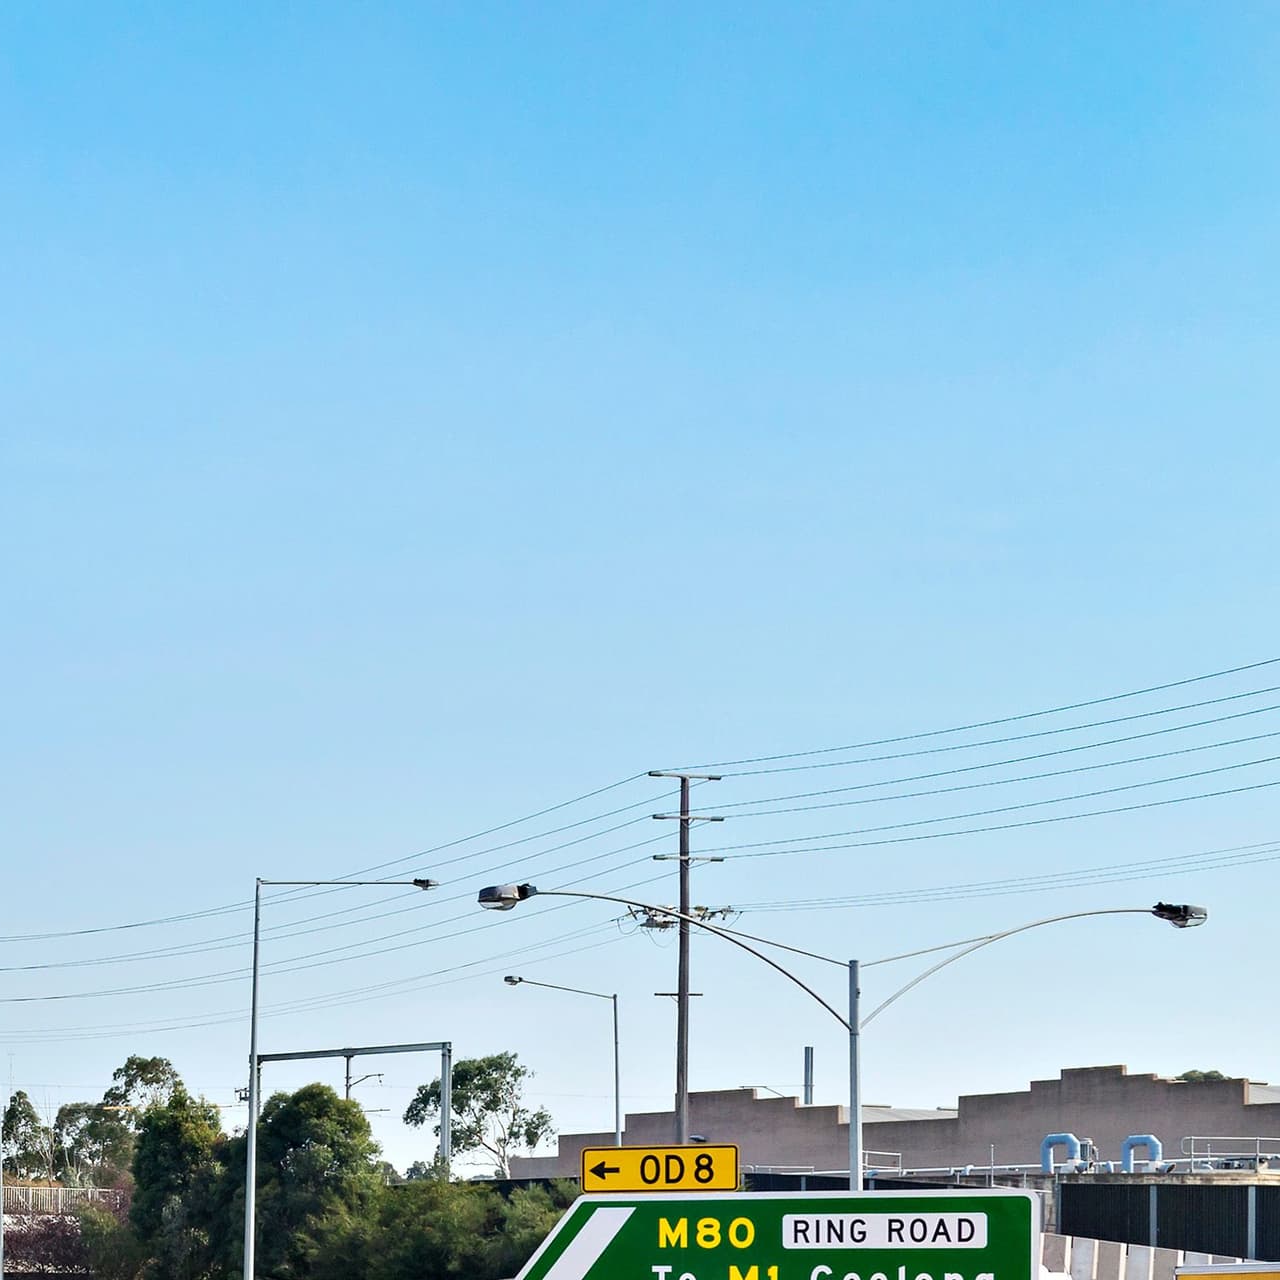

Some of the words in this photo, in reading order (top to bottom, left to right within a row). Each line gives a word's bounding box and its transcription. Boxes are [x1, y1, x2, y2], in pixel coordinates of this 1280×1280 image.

[658, 1217, 755, 1249] M80
[793, 1219, 867, 1243] RING
[887, 1218, 975, 1243] ROAD
